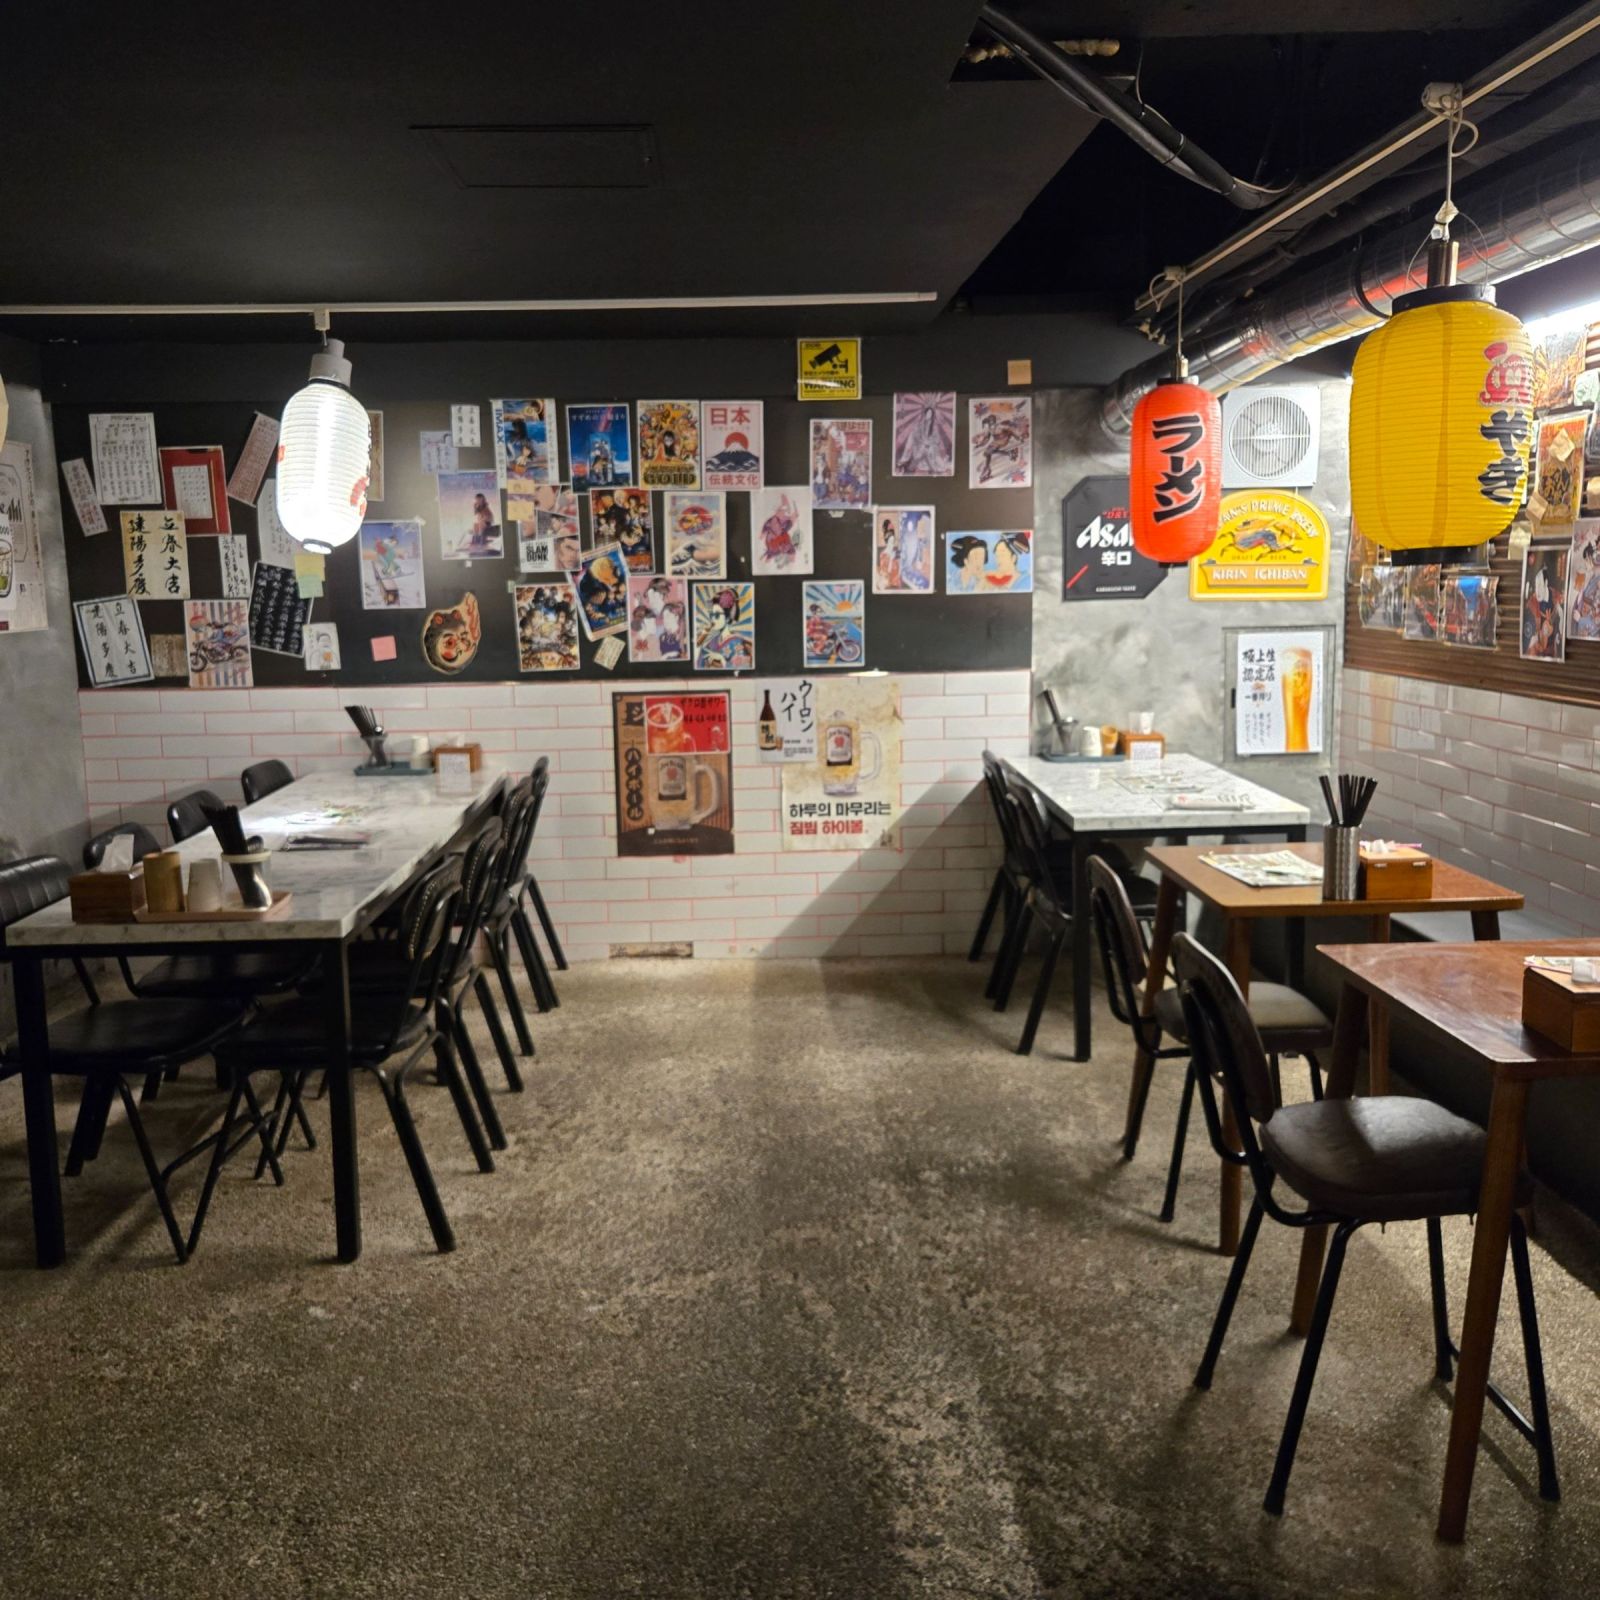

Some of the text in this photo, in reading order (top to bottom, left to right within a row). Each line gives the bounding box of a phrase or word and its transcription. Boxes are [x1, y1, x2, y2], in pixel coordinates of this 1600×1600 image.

[711, 407, 751, 425] 日本
[496, 409, 504, 443] IMAX
[1152, 415, 1203, 523] ラーメン
[710, 474, 758, 485] 伝統文化
[1251, 500, 1290, 516] PRIME
[1076, 515, 1134, 549] Asa
[526, 544, 549, 554] SLAM
[1101, 551, 1132, 566] 辛口
[1212, 567, 1308, 580] KIRIN ICHIBAN
[114, 602, 137, 675] 立春大吉
[1242, 648, 1275, 663] 極上生
[1242, 665, 1275, 682] 認定店
[781, 692, 797, 722] ハイ
[799, 680, 813, 733] ウーロン
[789, 801, 892, 818] 하루의 마무리는
